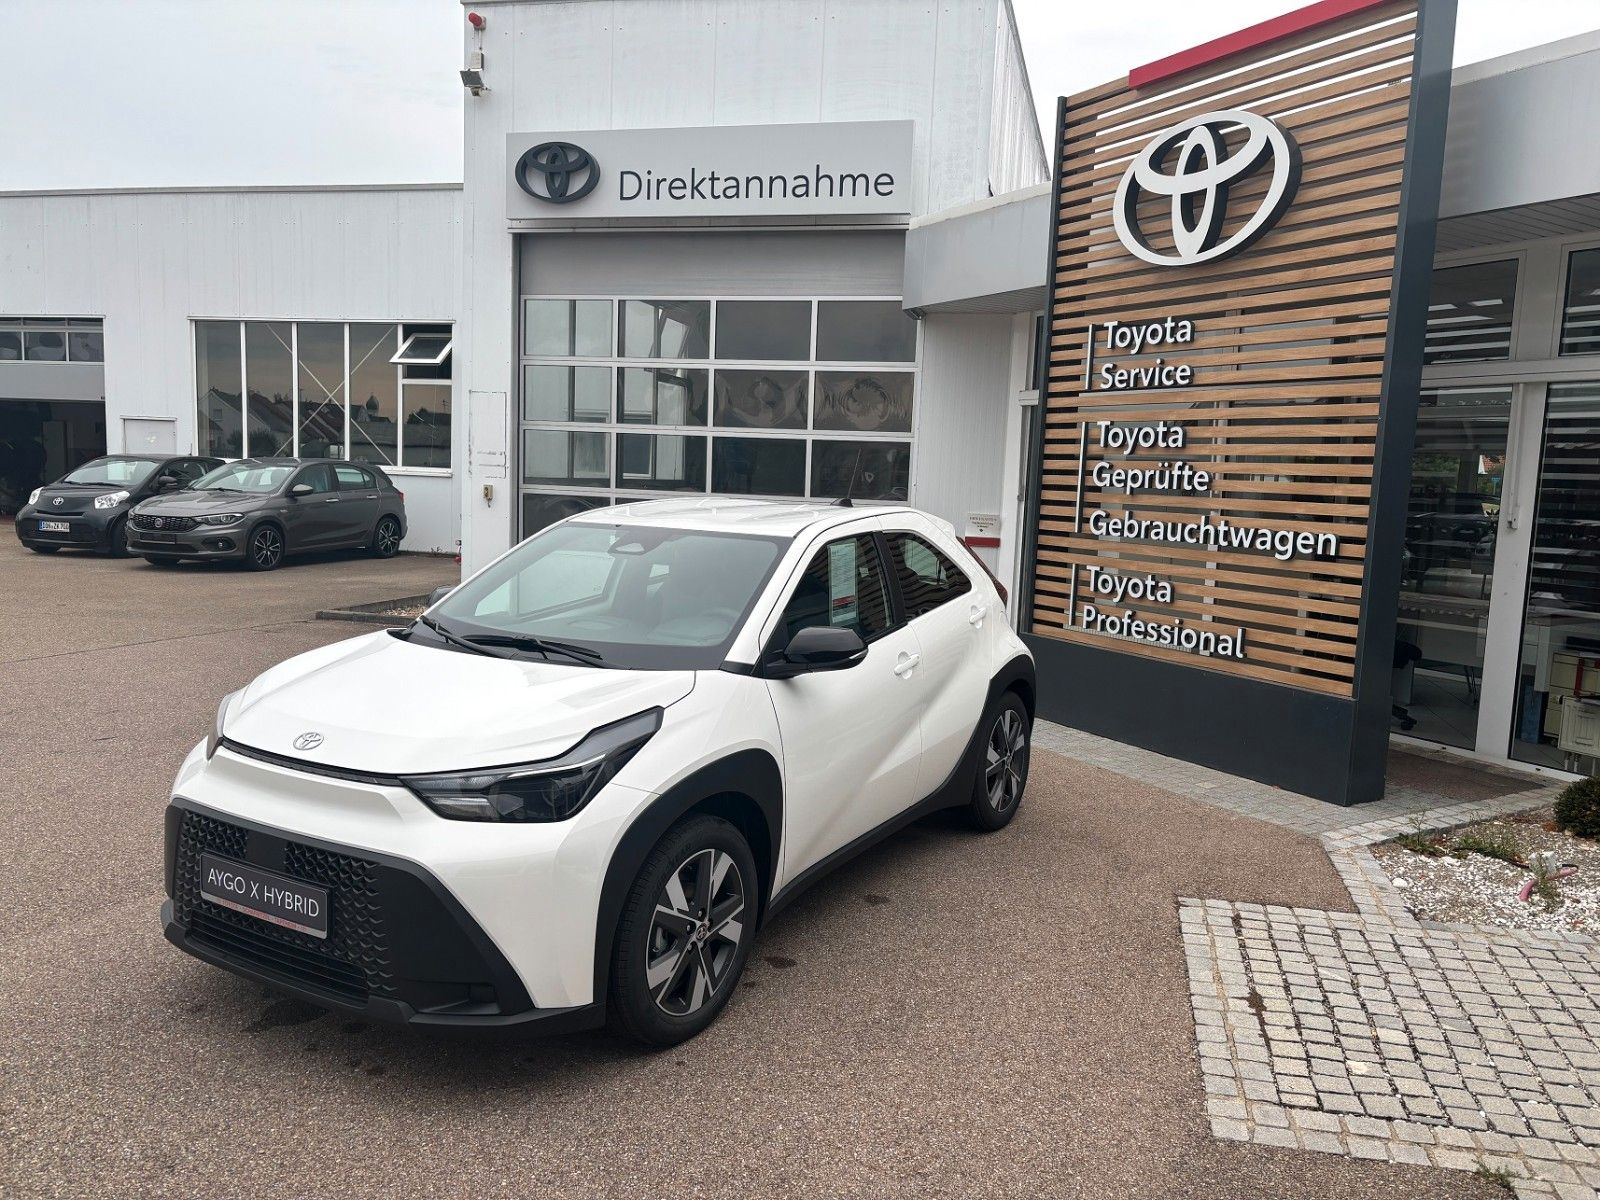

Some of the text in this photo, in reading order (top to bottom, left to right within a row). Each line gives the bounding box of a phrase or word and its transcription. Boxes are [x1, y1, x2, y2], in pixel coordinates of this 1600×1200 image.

[619, 163, 895, 201] Direktannahme
[1103, 316, 1192, 355] Toyota
[1100, 358, 1192, 389] Service
[1096, 420, 1184, 455] Toyota
[1092, 461, 1210, 495] Geprüfte
[1089, 509, 1338, 561] Gebrauchtwagen
[1086, 565, 1172, 603] Toyota
[1082, 605, 1245, 659] Professional
[207, 867, 246, 894] AYGO
[249, 880, 259, 900] X
[264, 885, 320, 917] HYBRID
